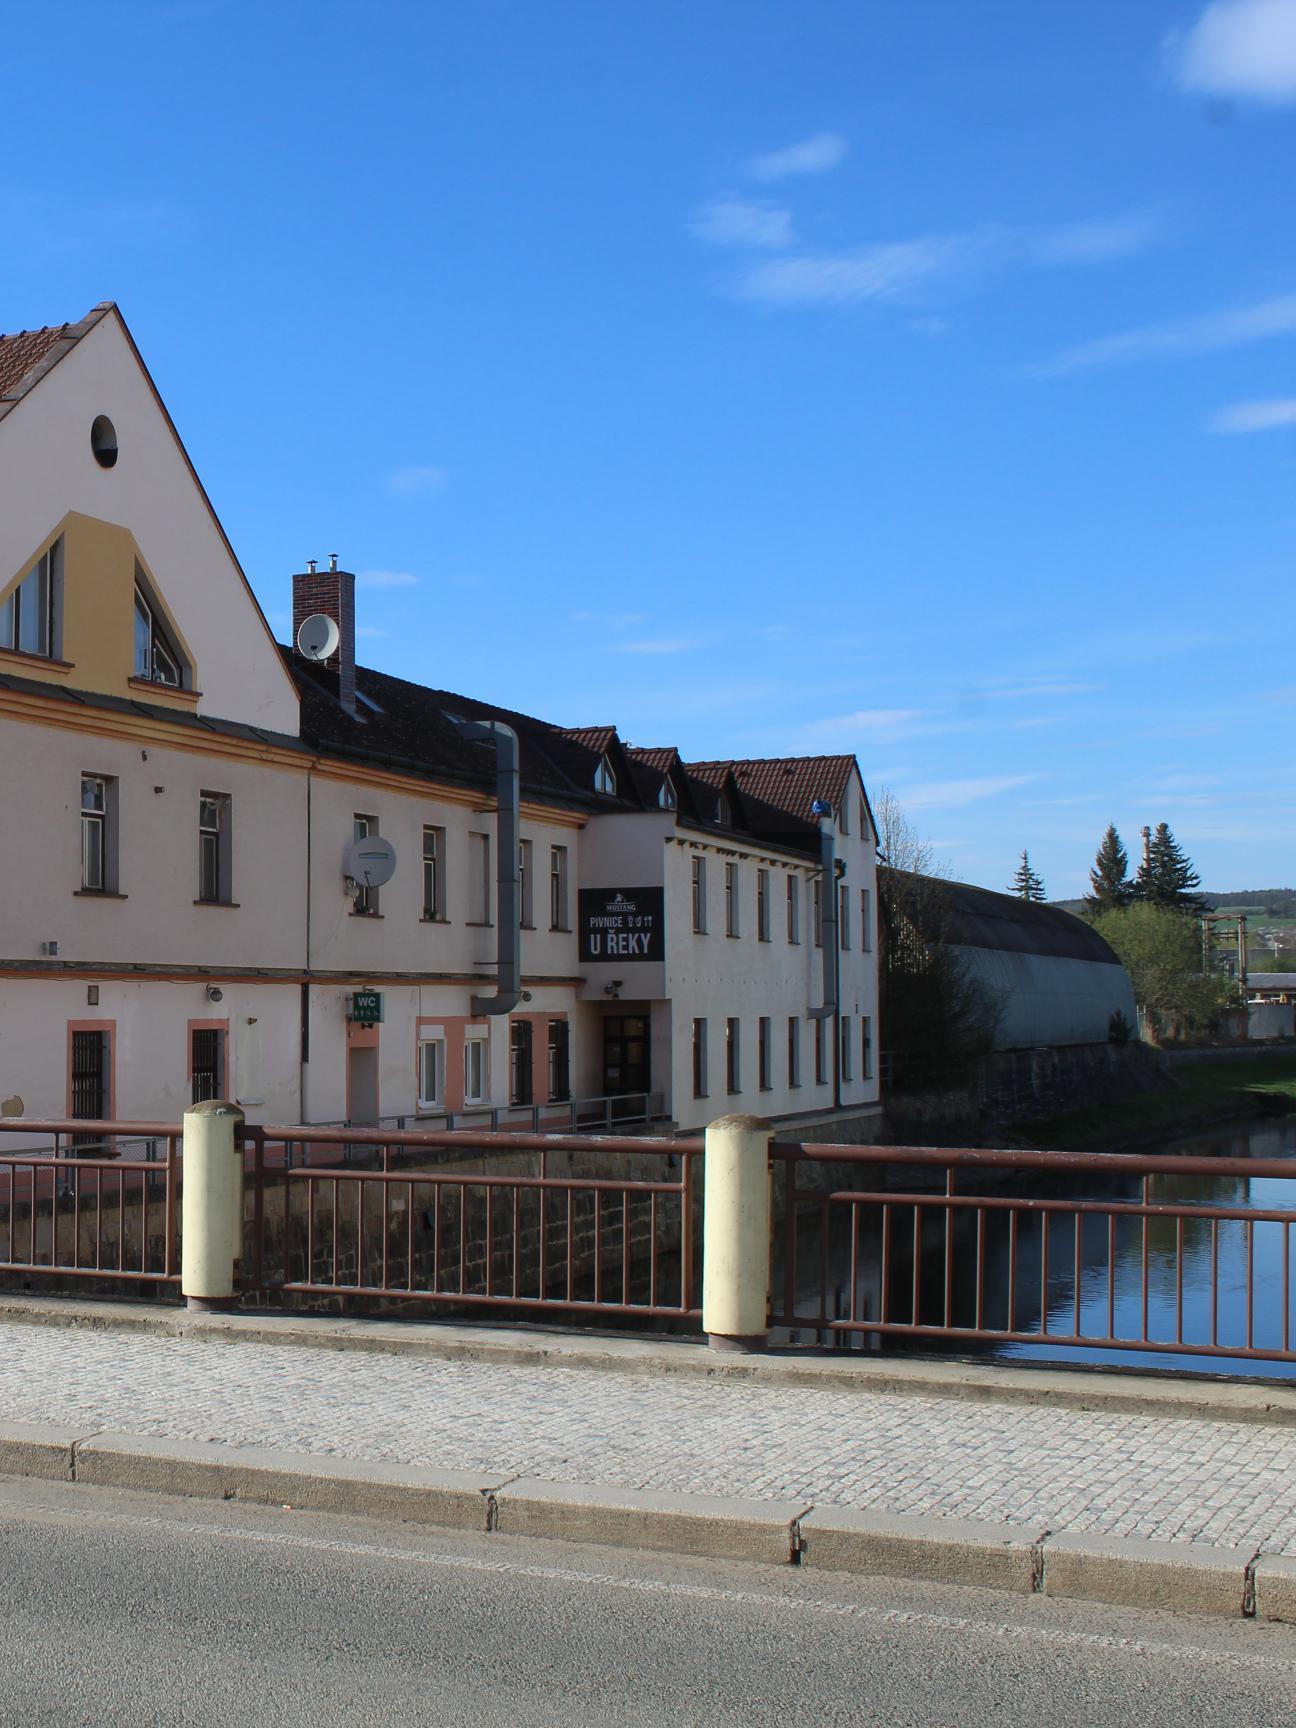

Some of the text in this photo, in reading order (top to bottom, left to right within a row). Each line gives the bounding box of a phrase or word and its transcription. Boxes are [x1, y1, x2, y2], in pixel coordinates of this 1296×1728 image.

[590, 916, 623, 928] PIVNICE
[590, 929, 651, 954] U ŘEKY
[357, 996, 376, 1007] WC
